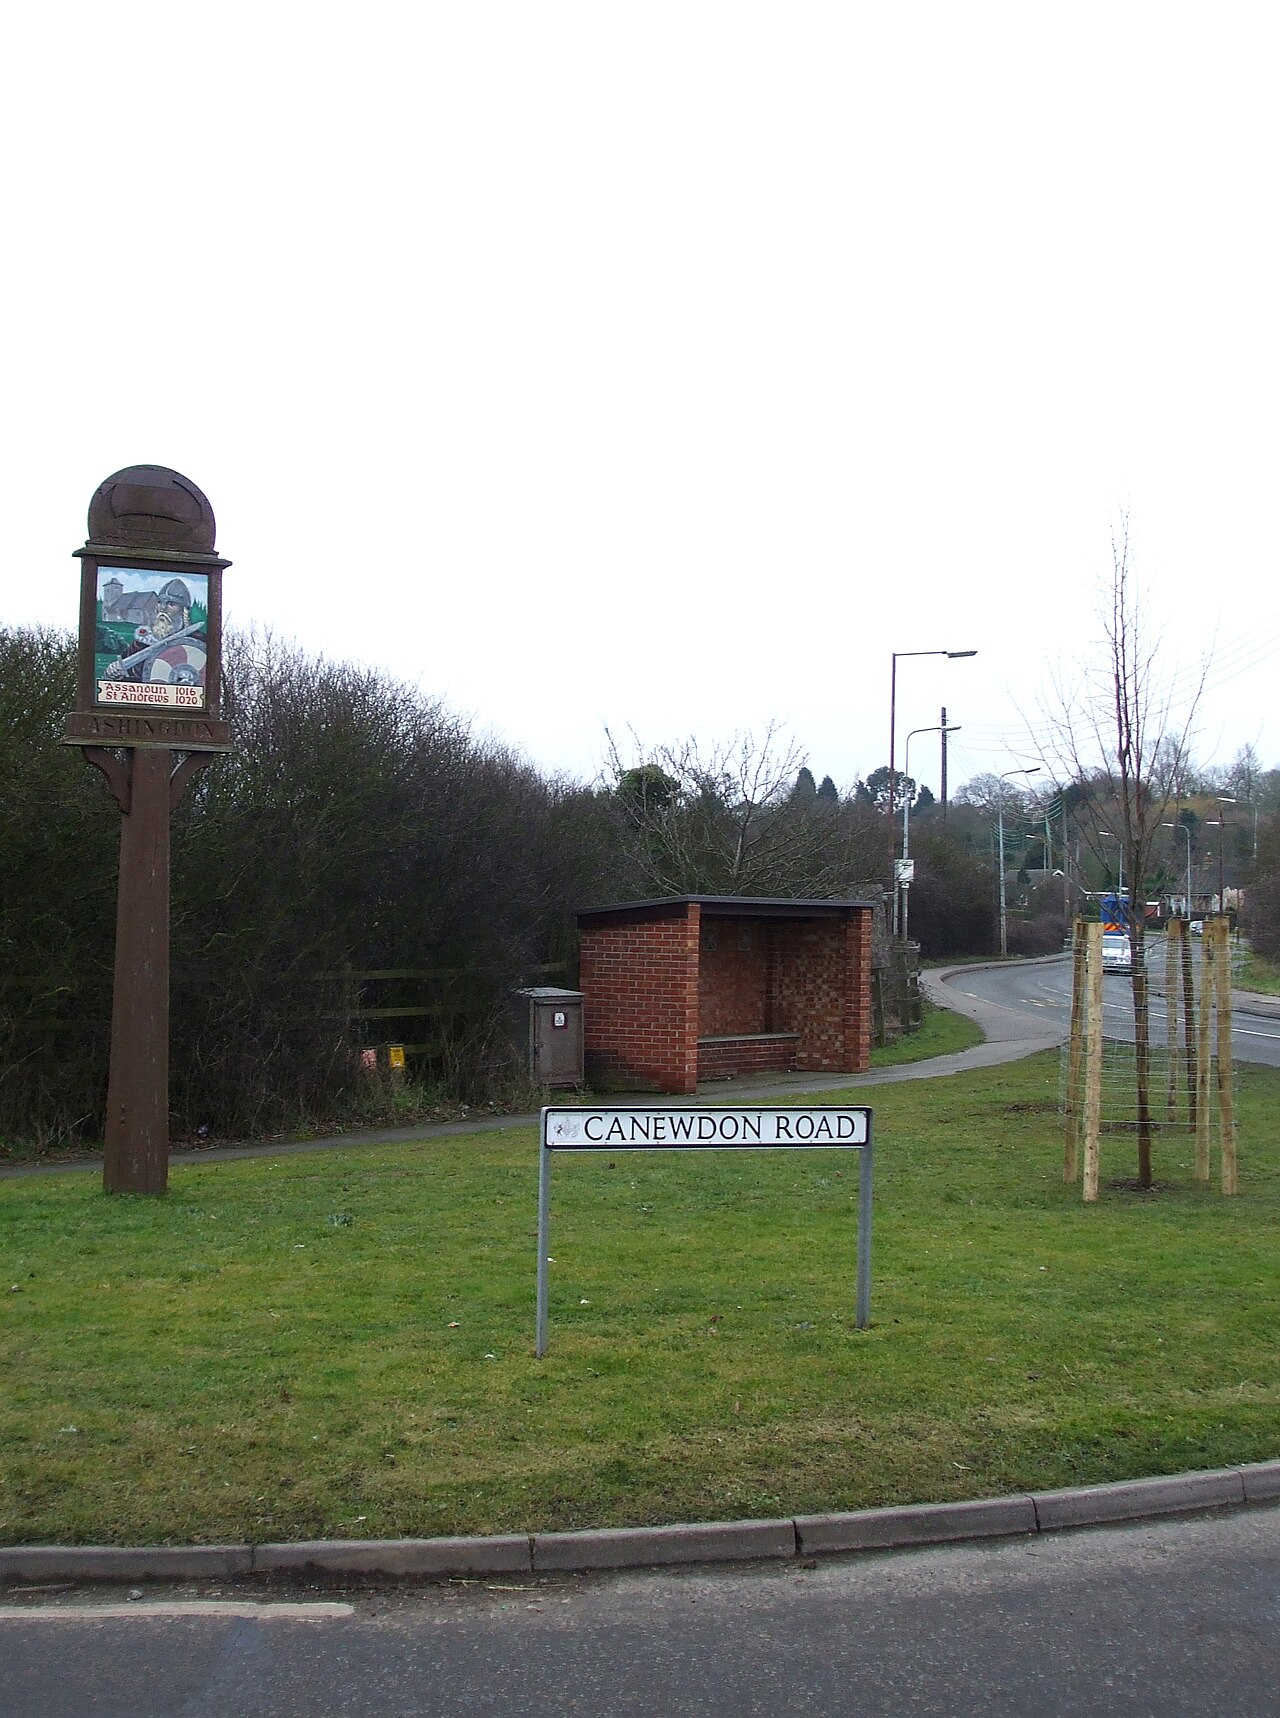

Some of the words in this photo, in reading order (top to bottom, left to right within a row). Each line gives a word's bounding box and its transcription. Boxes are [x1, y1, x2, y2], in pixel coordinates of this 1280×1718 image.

[105, 691, 117, 701] St
[121, 692, 169, 703] Andrews
[175, 696, 198, 705] 1020
[175, 687, 196, 696] 1016
[88, 717, 214, 738] ASHINGDON
[584, 1115, 762, 1141] CANEWDON
[775, 1115, 856, 1140] ROAD
